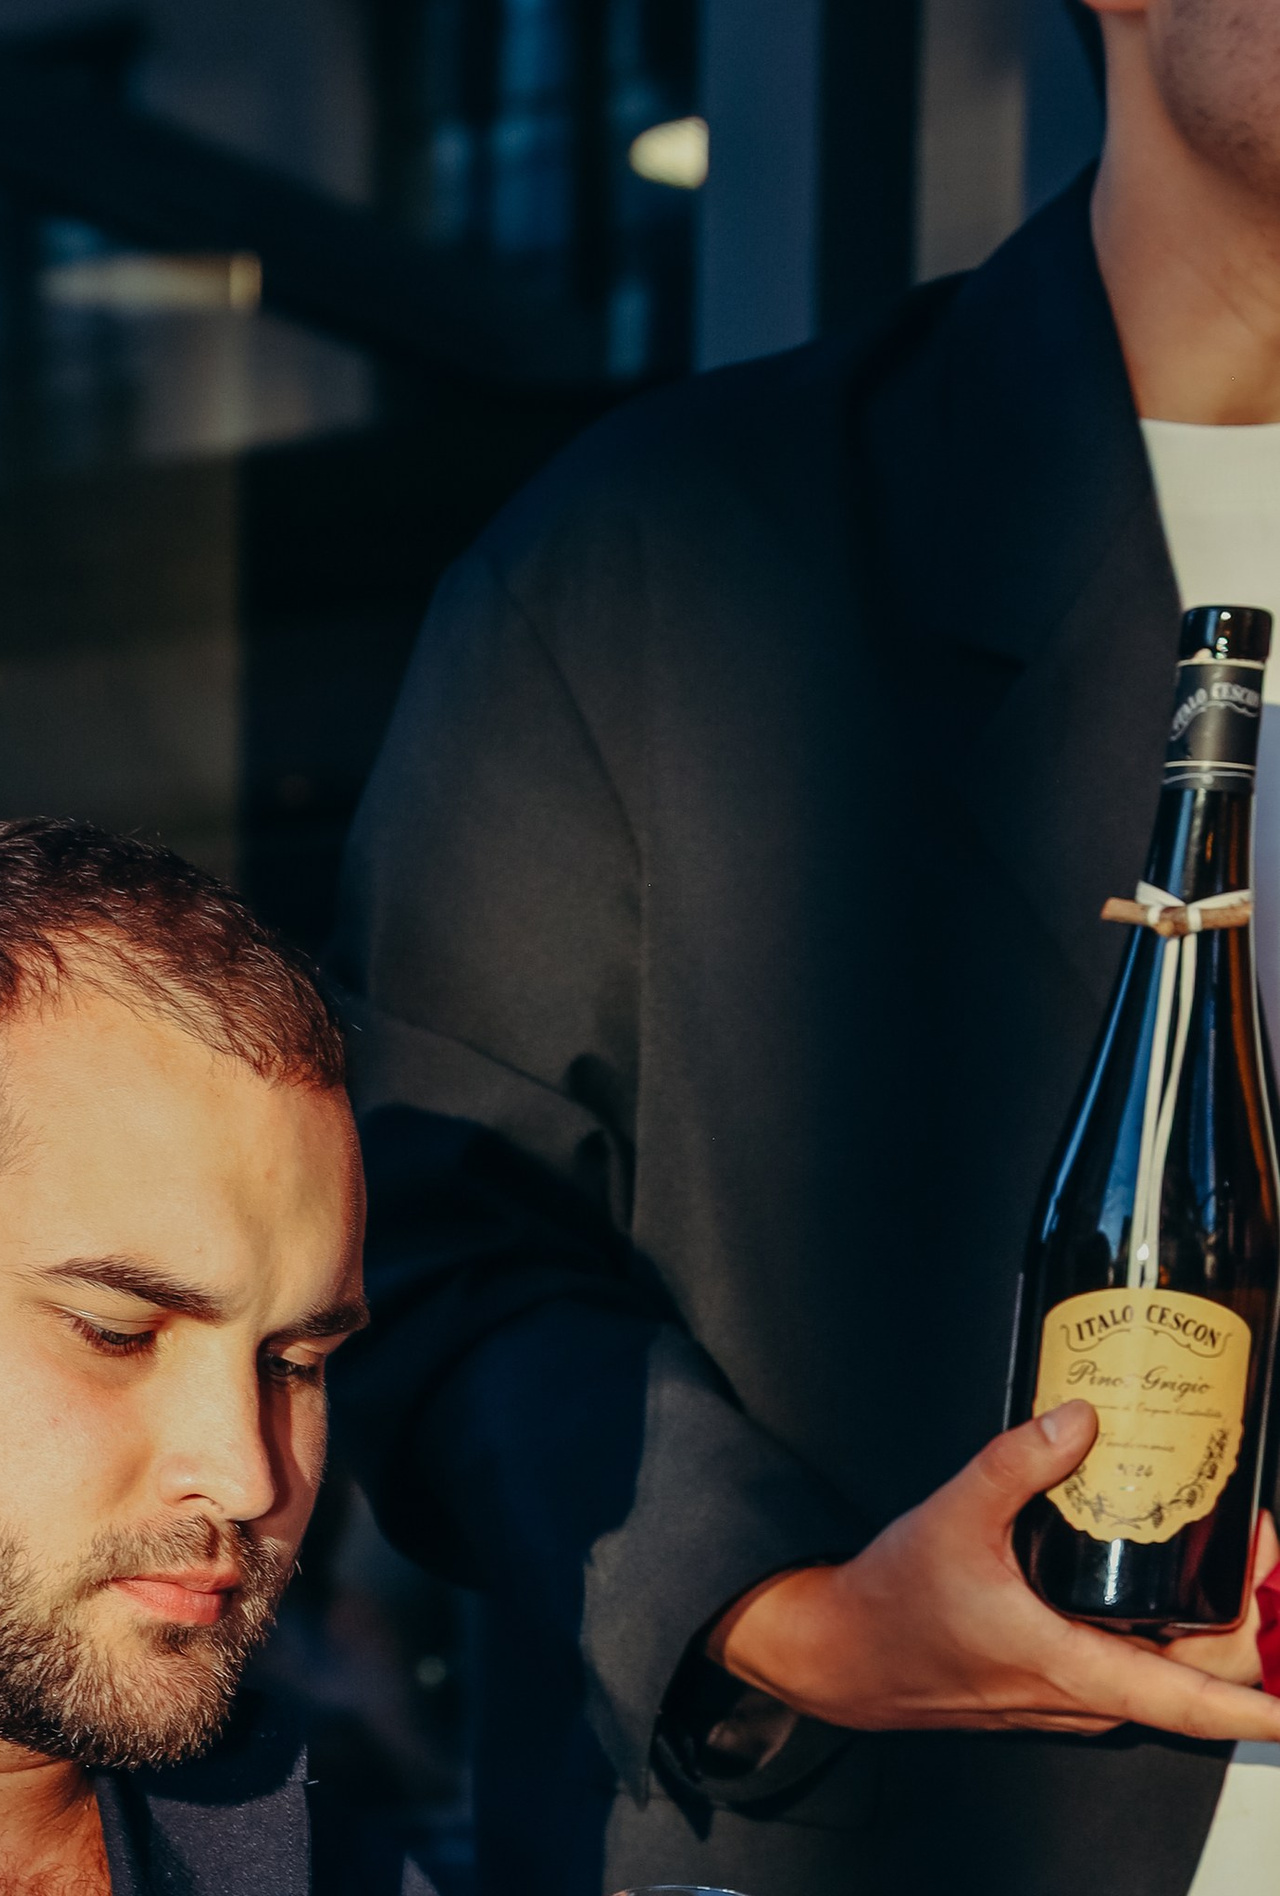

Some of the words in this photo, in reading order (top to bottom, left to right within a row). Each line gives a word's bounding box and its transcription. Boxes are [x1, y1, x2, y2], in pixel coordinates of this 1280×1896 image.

[1076, 1305, 1134, 1341] ITALO
[1146, 1304, 1221, 1349] CESCON
[1141, 1365, 1214, 1401] Grigio
